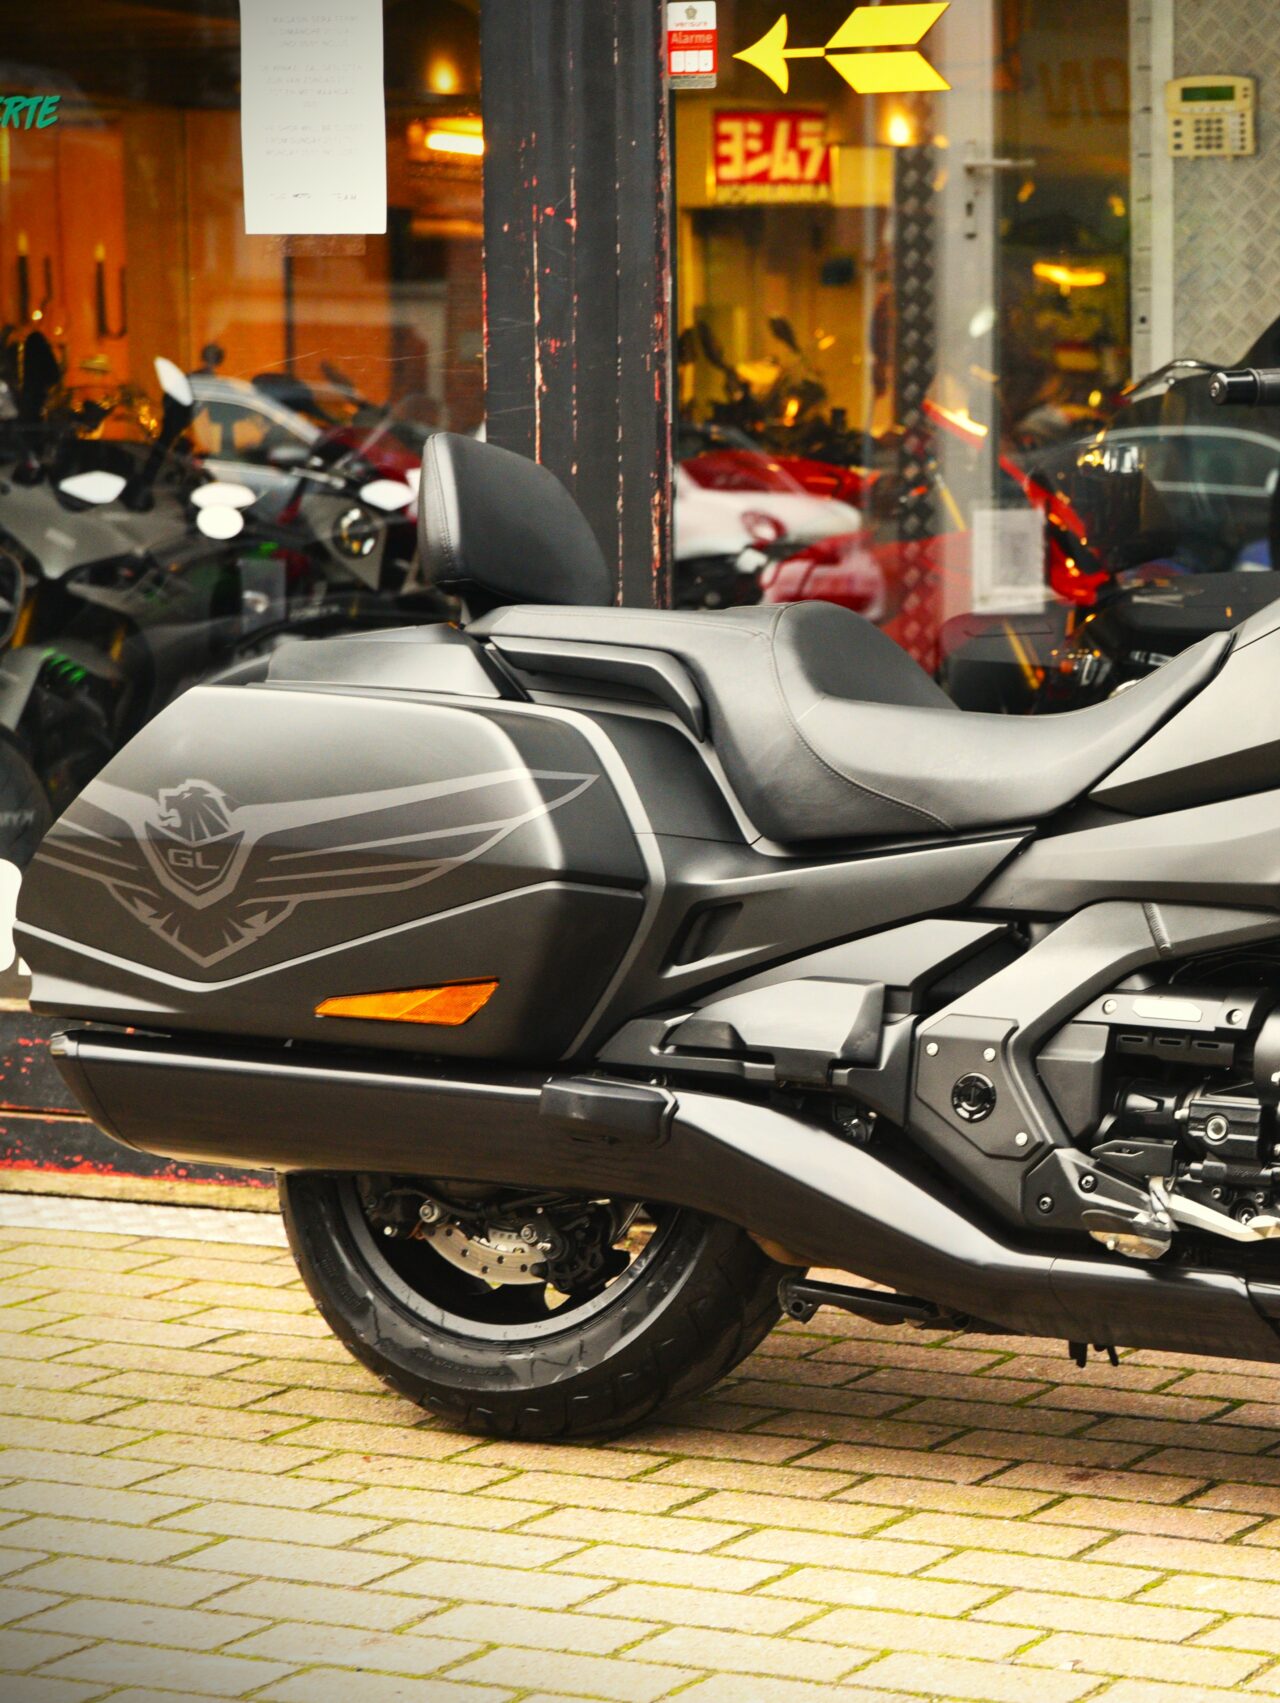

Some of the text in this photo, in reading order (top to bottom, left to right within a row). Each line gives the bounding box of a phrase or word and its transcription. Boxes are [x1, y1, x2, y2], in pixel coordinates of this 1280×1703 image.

[671, 31, 713, 44] Alarme
[0, 95, 61, 130] RTE
[718, 119, 826, 181] ヨシムラ
[168, 848, 220, 870] GL
